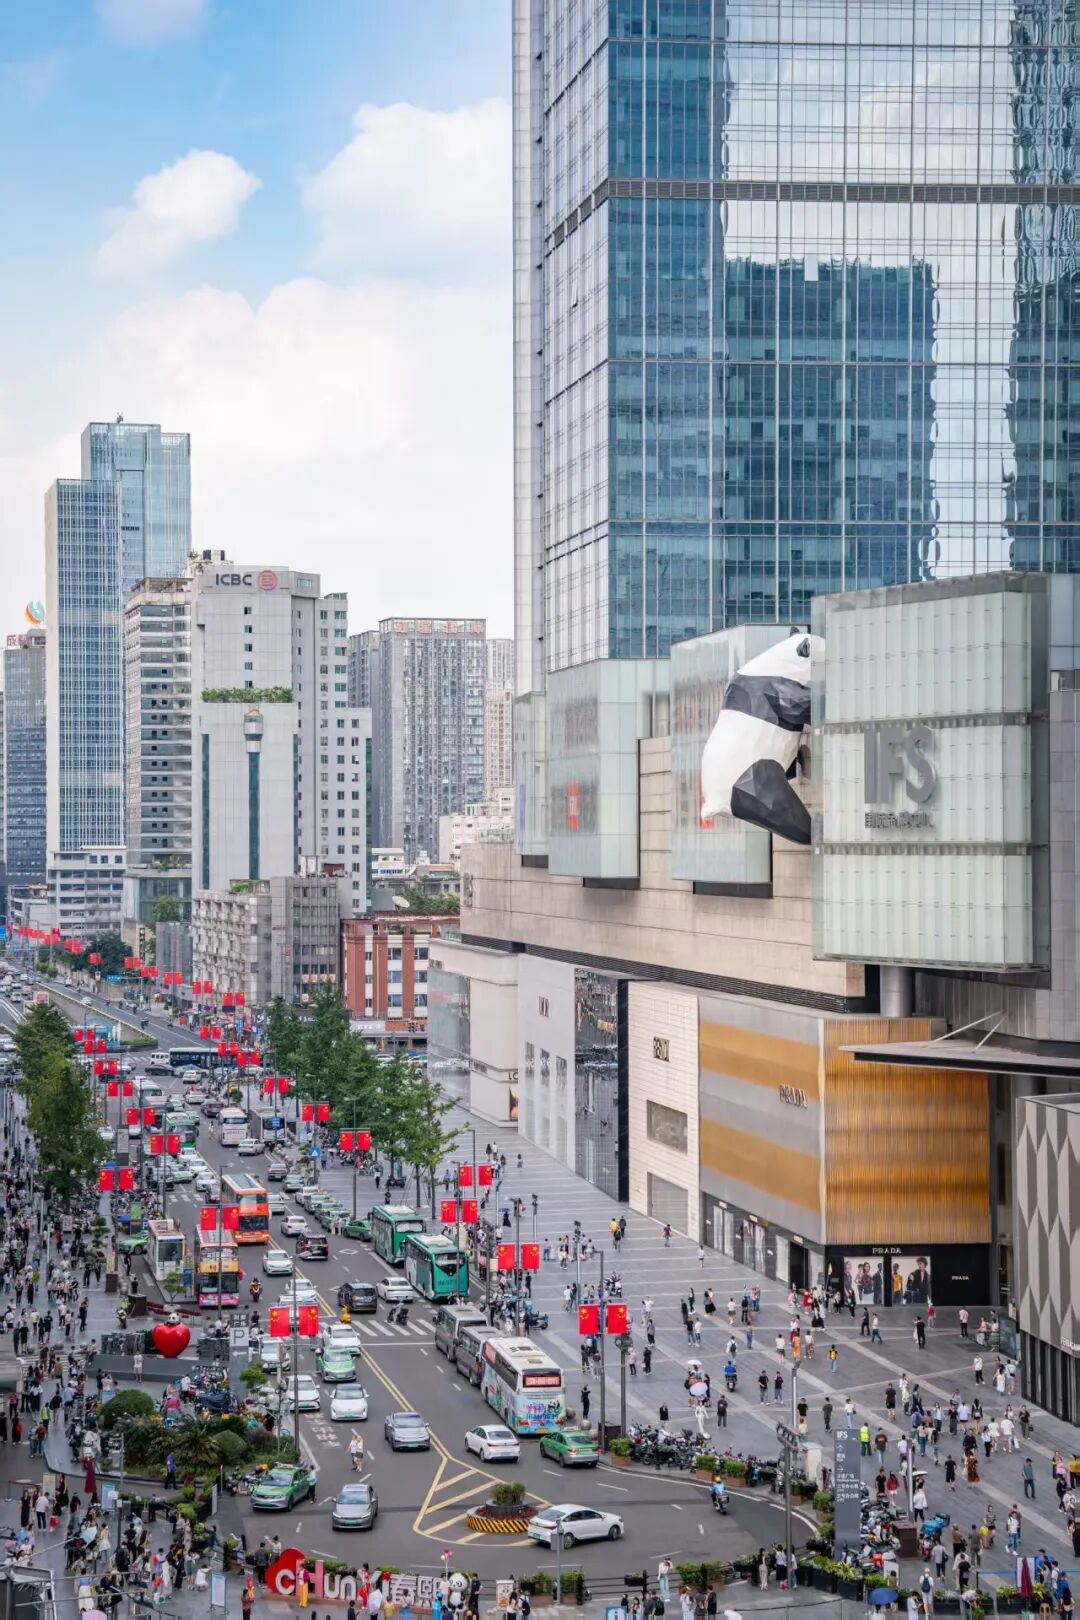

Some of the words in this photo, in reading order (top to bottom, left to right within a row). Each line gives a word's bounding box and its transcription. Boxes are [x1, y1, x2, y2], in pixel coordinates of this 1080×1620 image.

[215, 573, 252, 586] ICBC
[863, 724, 936, 804] IFS
[872, 1247, 902, 1255] PRADA
[233, 1329, 245, 1345] P
[837, 1431, 848, 1440] IFS
